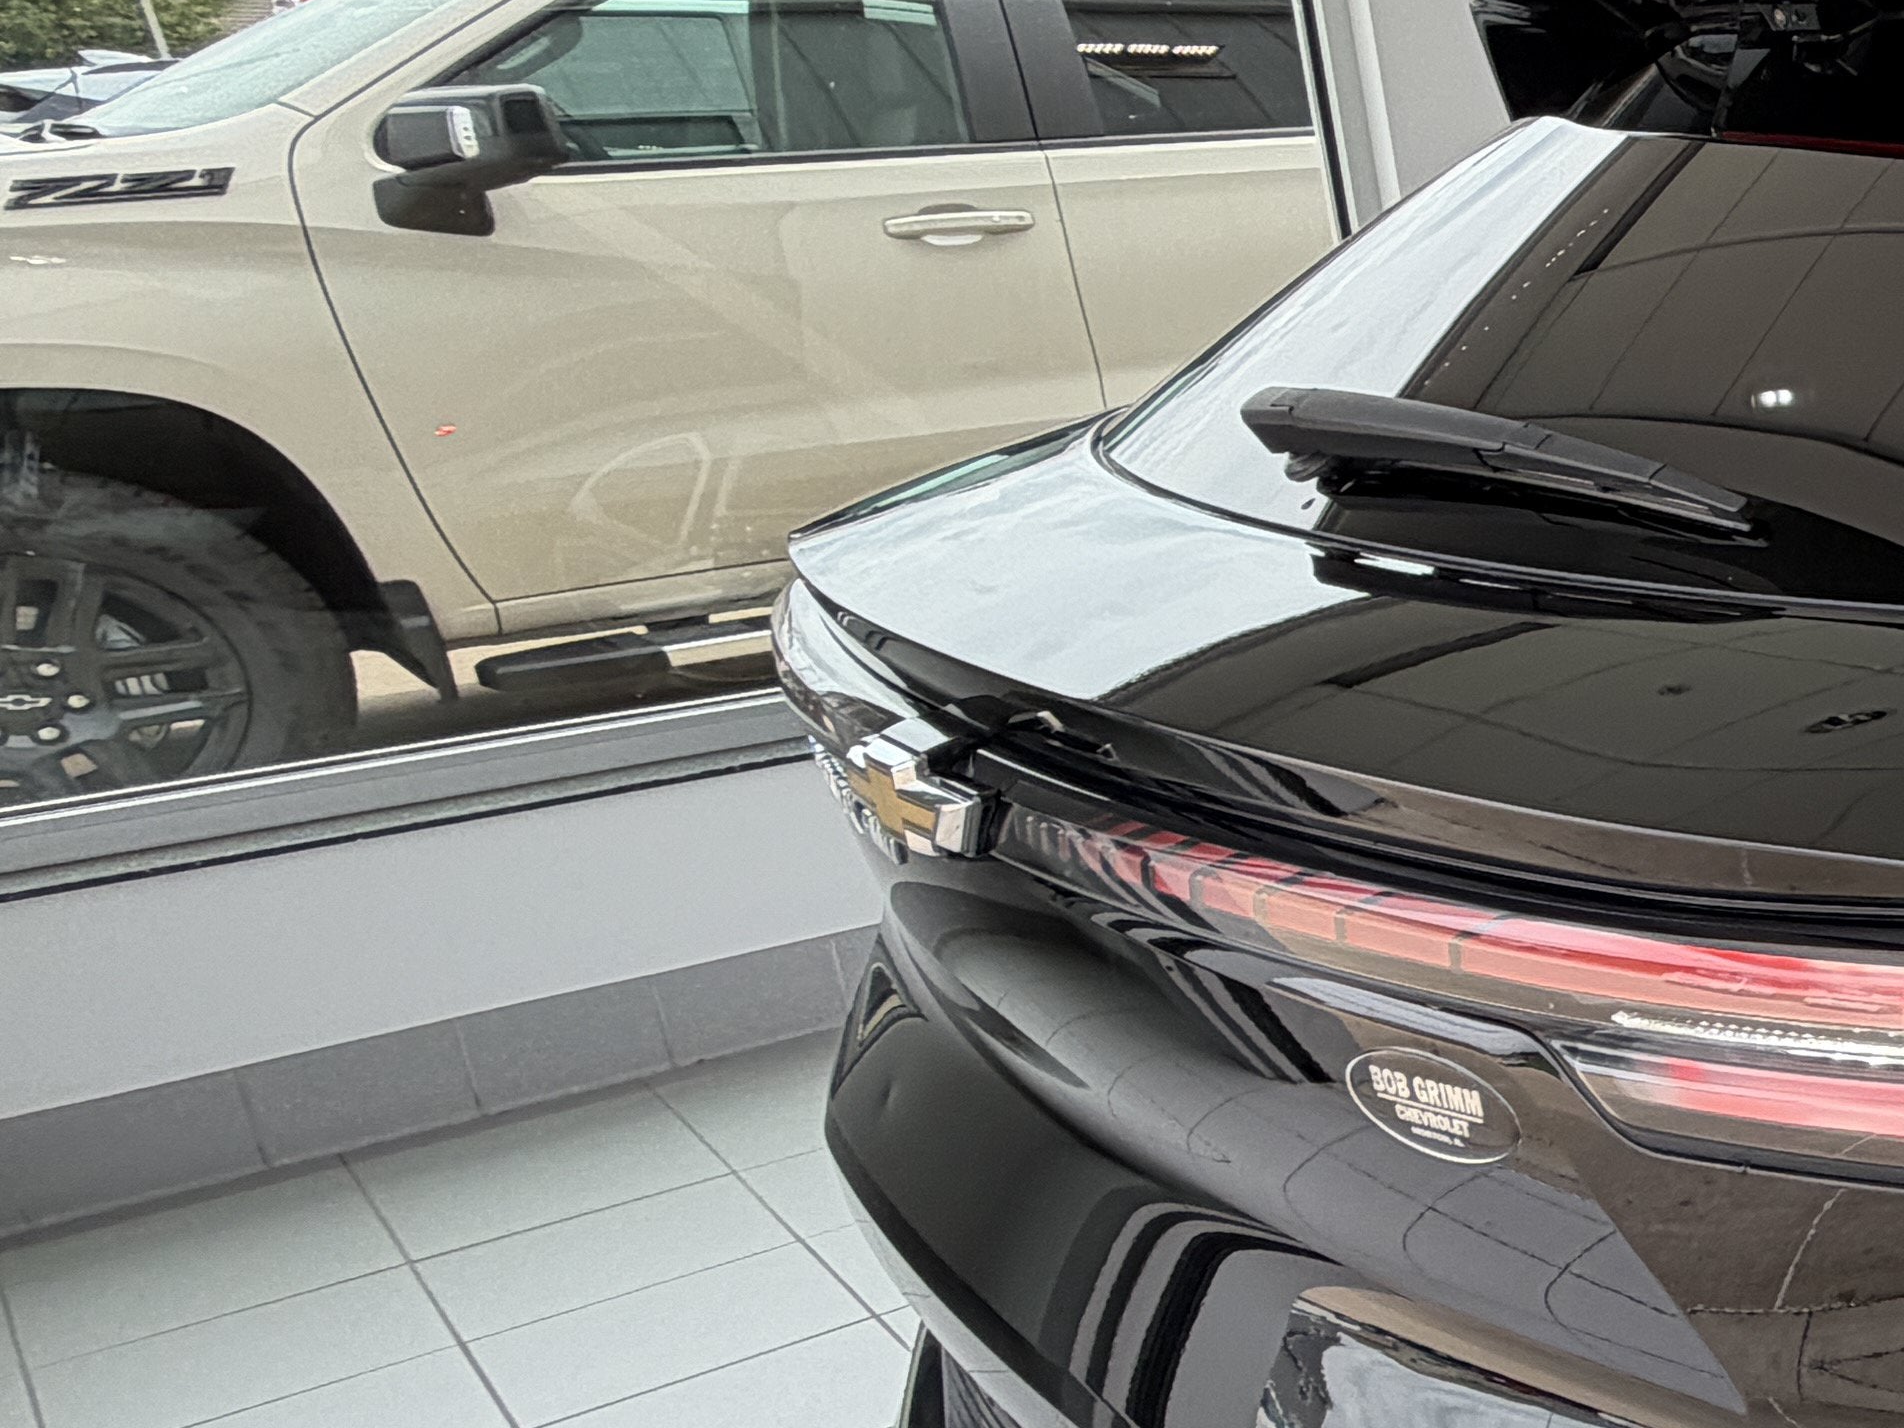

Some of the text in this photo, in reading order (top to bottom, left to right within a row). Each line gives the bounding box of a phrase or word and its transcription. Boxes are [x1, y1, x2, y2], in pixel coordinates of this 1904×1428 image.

[3, 167, 236, 210] Z71
[1368, 1064, 1484, 1117] BOB GRIMM
[1395, 1104, 1470, 1138] CHEVROLET
